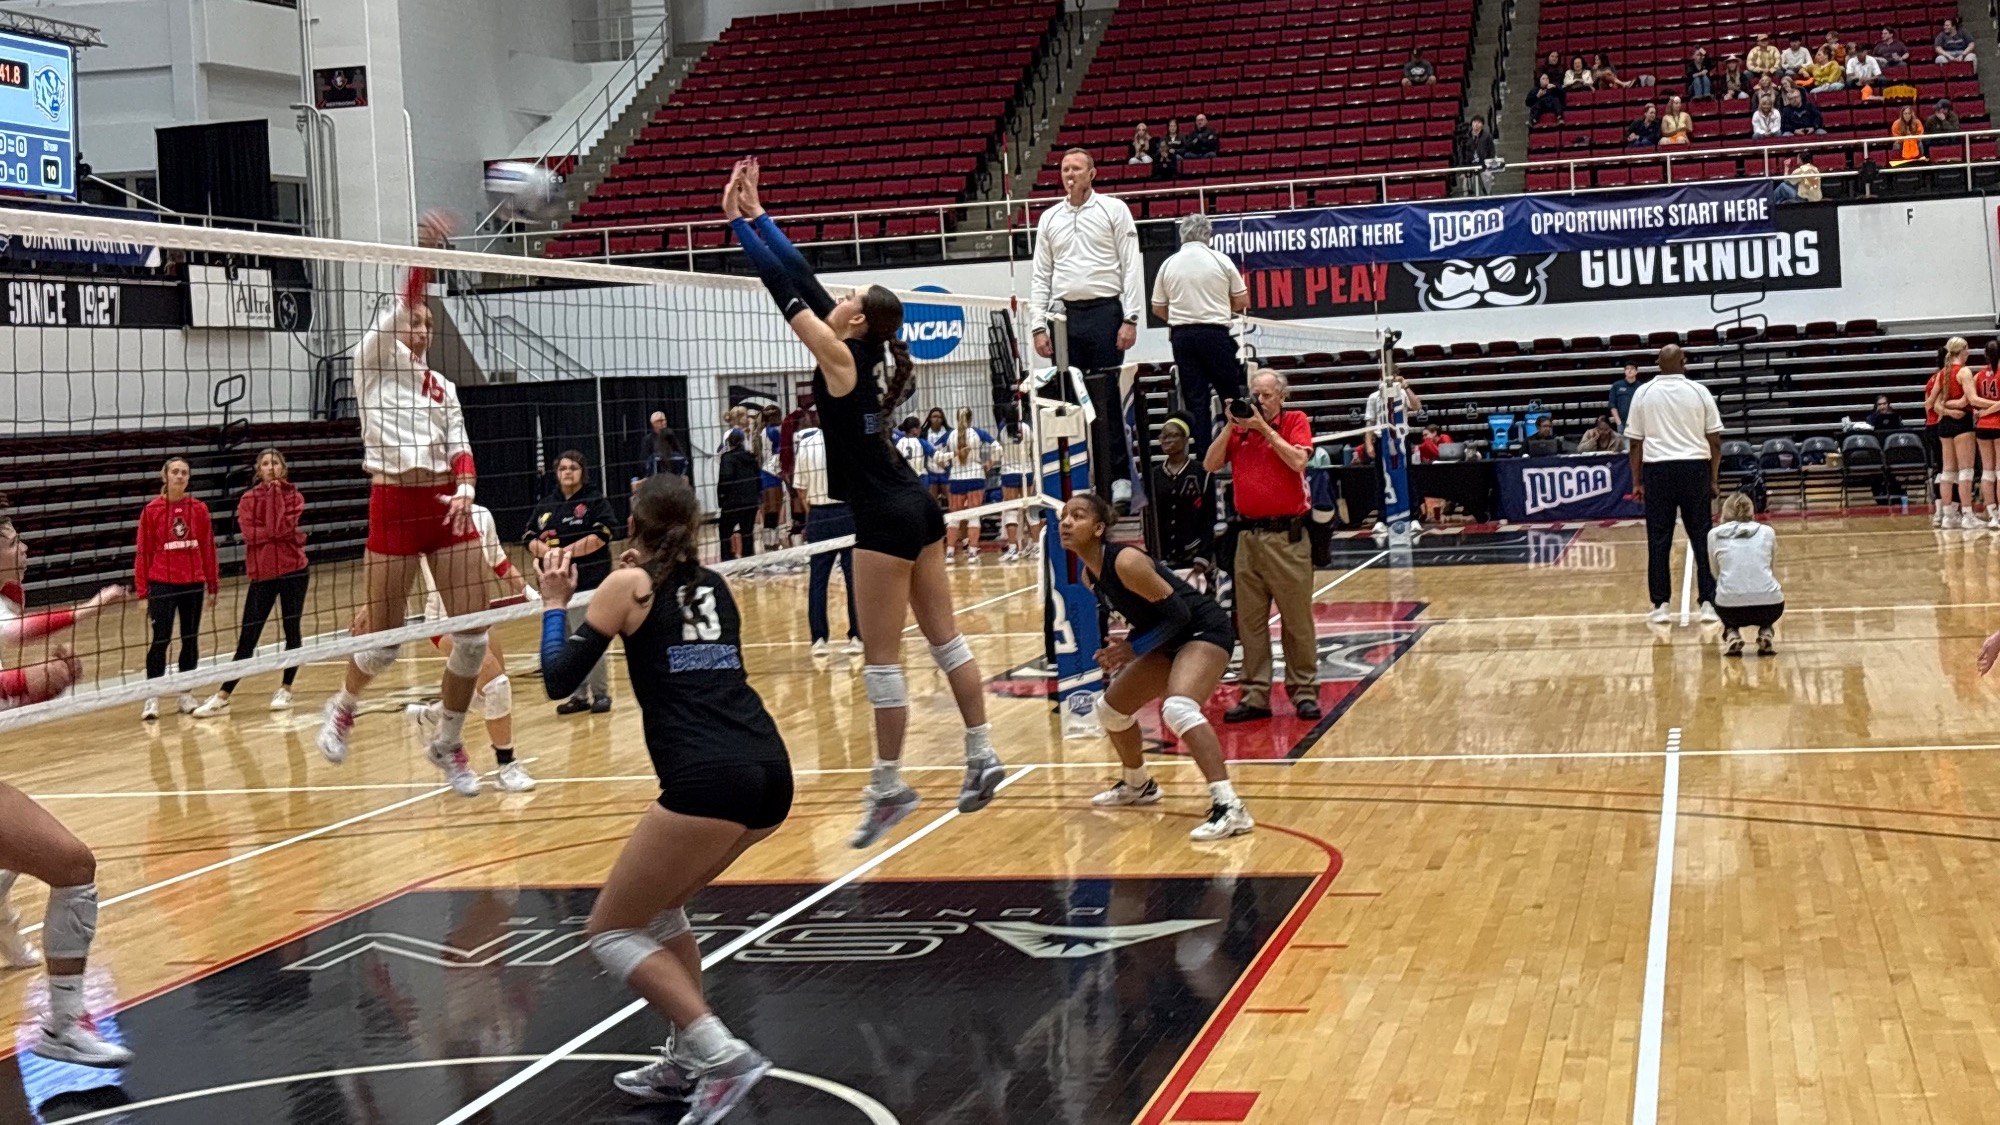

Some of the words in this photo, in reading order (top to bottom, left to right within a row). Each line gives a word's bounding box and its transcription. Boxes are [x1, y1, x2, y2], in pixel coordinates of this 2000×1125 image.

[46, 165, 57, 180] 10
[1310, 224, 1359, 250] START
[1362, 222, 1405, 246] HERE
[1429, 207, 1504, 251] NJCAA
[1531, 205, 1665, 236] OPPORTUNITIES
[1668, 202, 1719, 227] START
[1723, 197, 1770, 222] HERE
[1906, 208, 1914, 225] F
[1580, 230, 1820, 288] GOVERNORS
[1305, 262, 1389, 305] PEAY
[8, 281, 67, 325] SINCE
[78, 284, 121, 326] 1927
[901, 319, 963, 342] NCAA
[1982, 379, 1999, 399] 14
[1523, 466, 1612, 515] NJCAA
